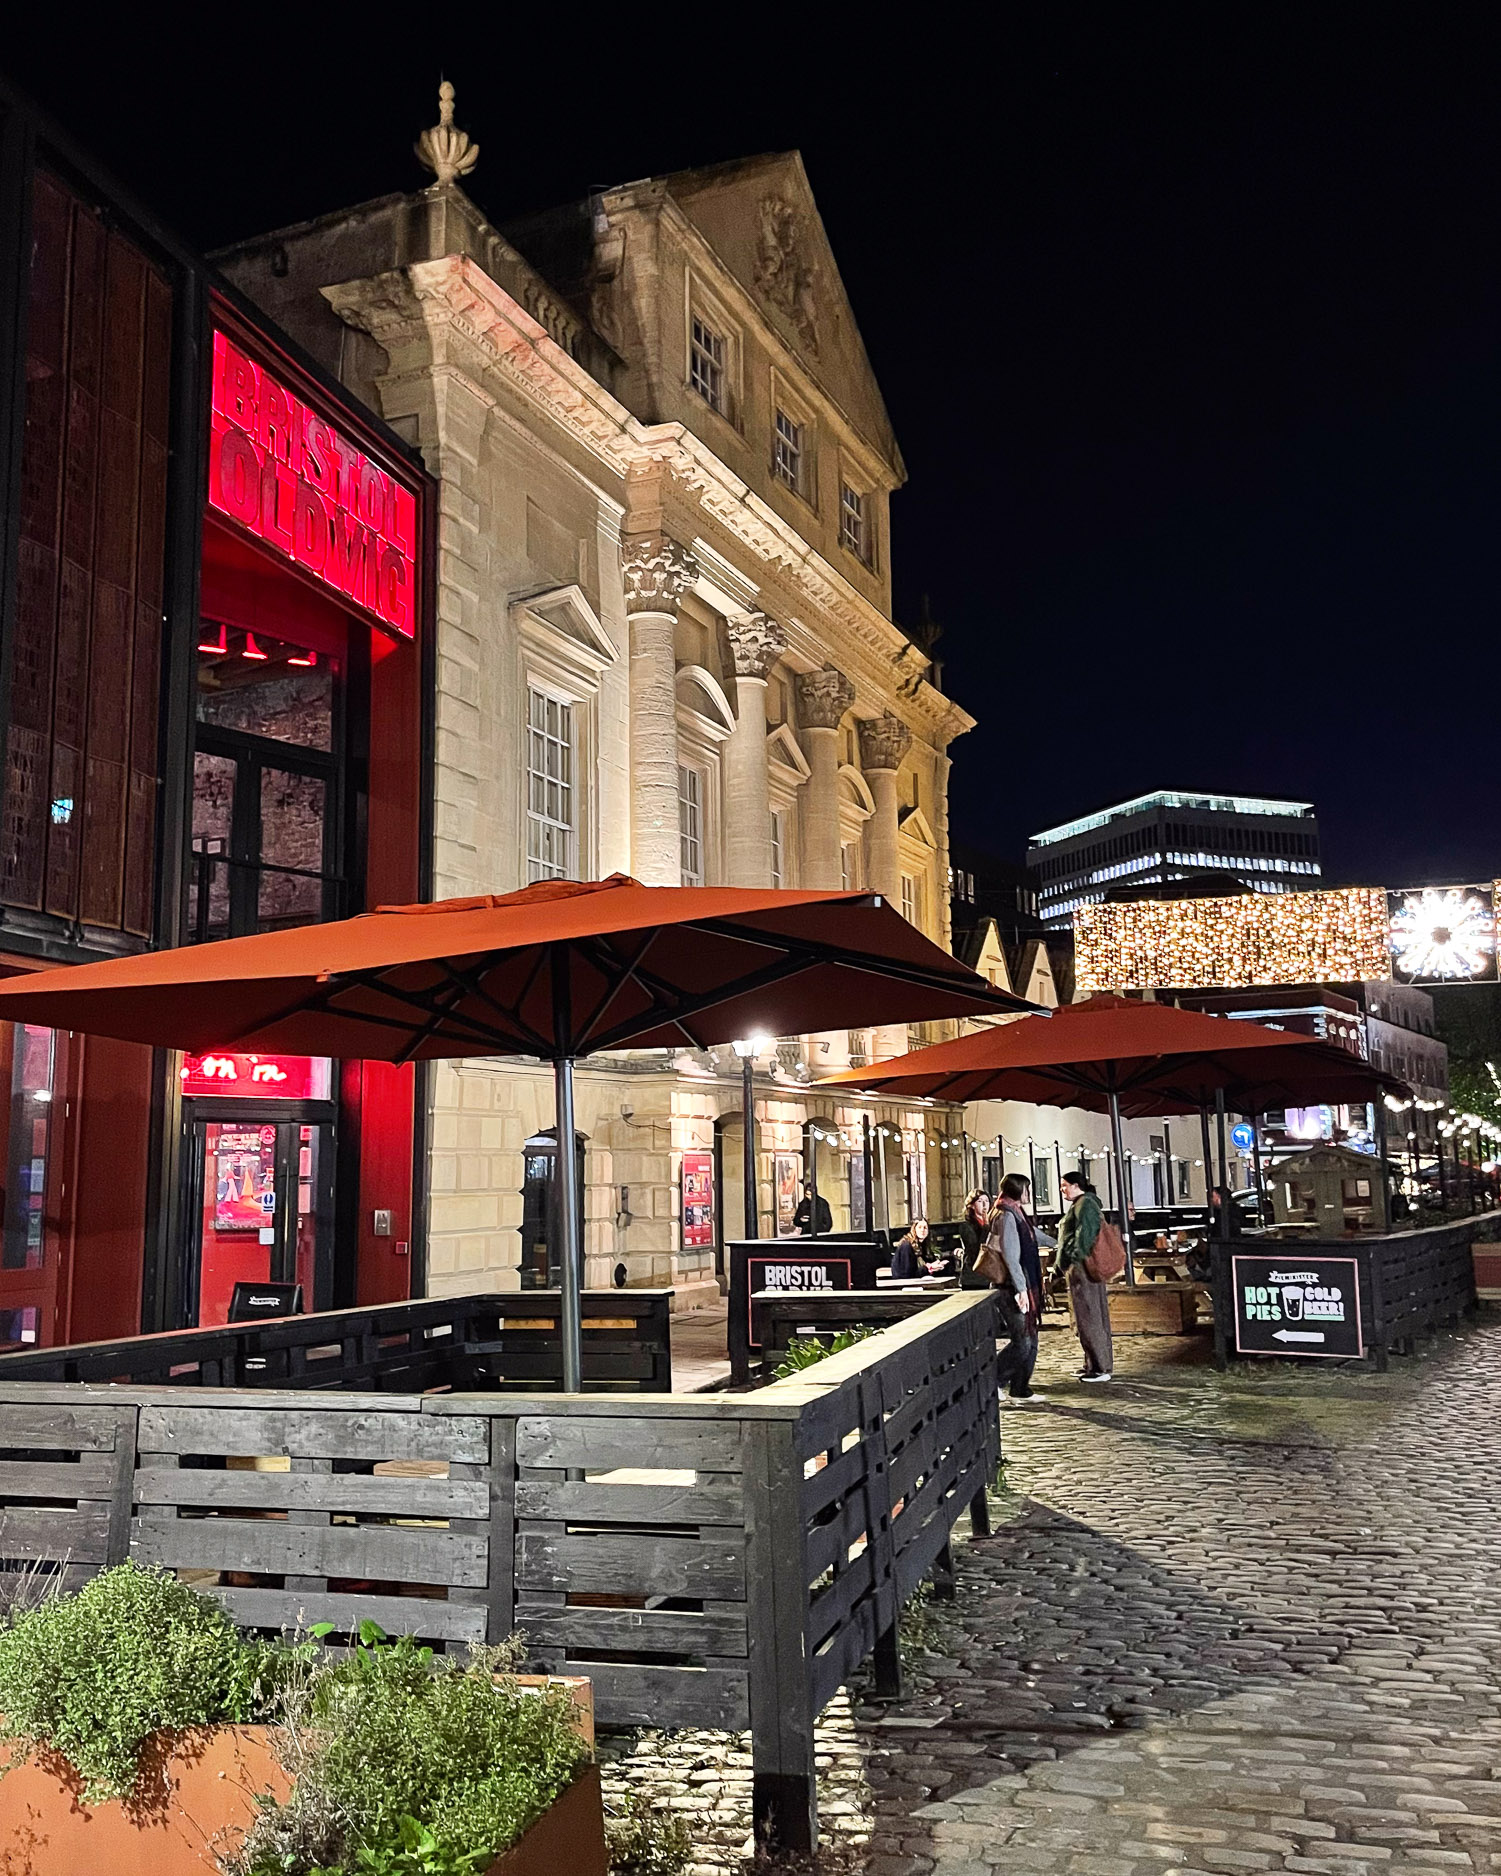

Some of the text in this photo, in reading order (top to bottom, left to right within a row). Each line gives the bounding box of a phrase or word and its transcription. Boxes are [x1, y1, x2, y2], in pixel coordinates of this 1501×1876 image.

[224, 341, 407, 554] BRISTOL
[220, 426, 407, 628] OLD VIC
[764, 1265, 833, 1287] BRISTOL
[1244, 1286, 1280, 1304] HOT
[1304, 1286, 1342, 1301] COLD
[1245, 1304, 1282, 1321] PIES
[1303, 1300, 1344, 1316] BEER!
